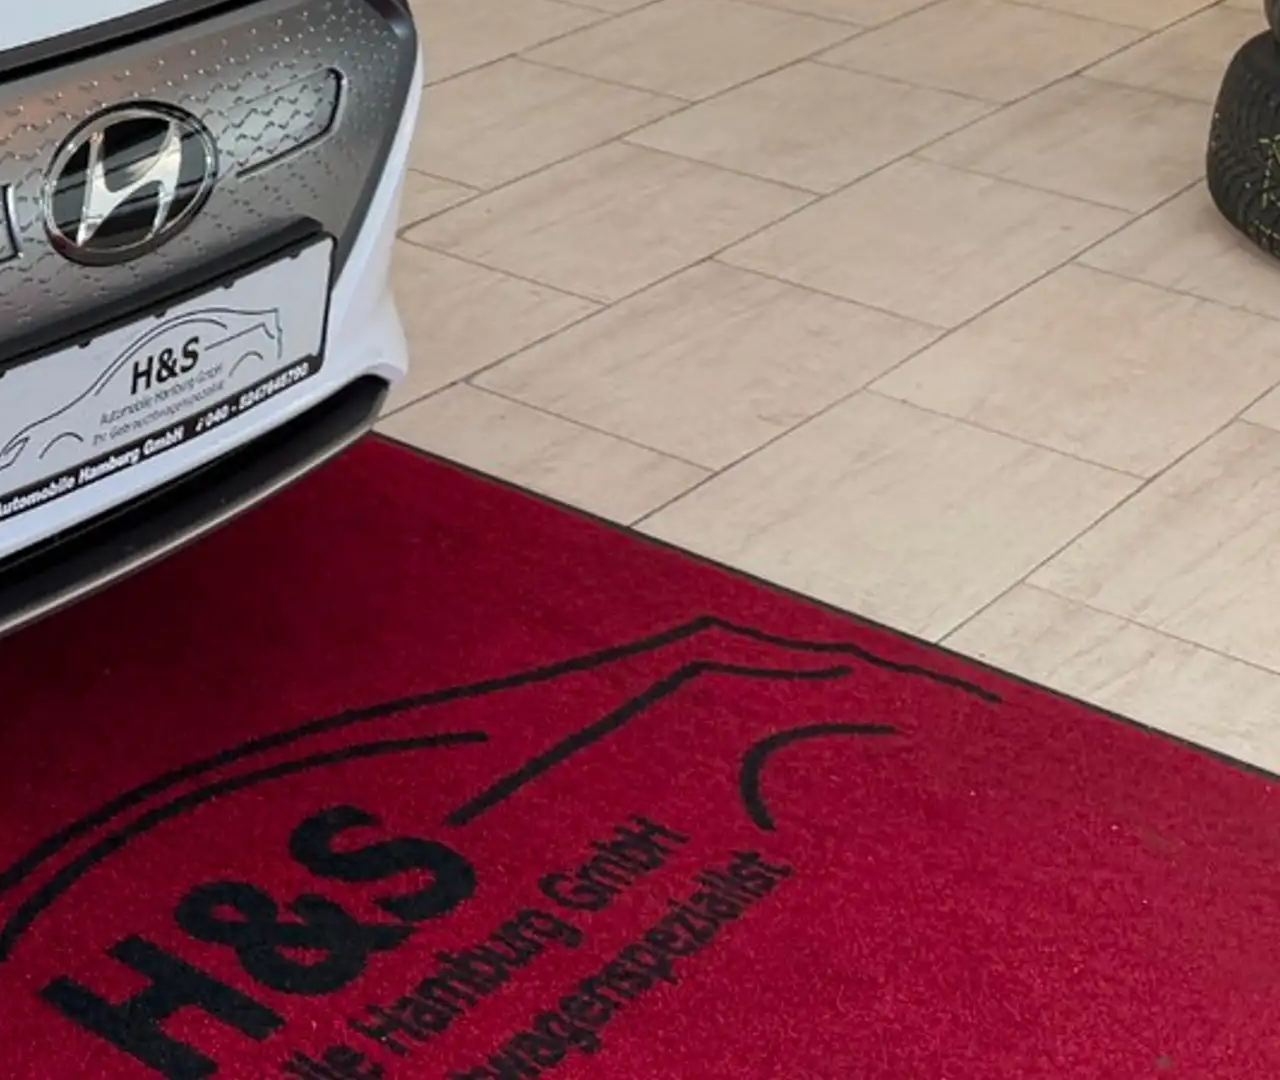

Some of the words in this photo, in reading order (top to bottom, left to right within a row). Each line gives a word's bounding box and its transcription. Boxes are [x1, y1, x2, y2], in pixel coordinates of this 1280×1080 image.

[130, 335, 200, 395] H&S
[78, 447, 141, 484] Hamburg
[142, 426, 185, 455] GmbH
[36, 805, 477, 1080] H&S
[347, 908, 584, 1057] Hamburg
[538, 816, 691, 912] GmbH
